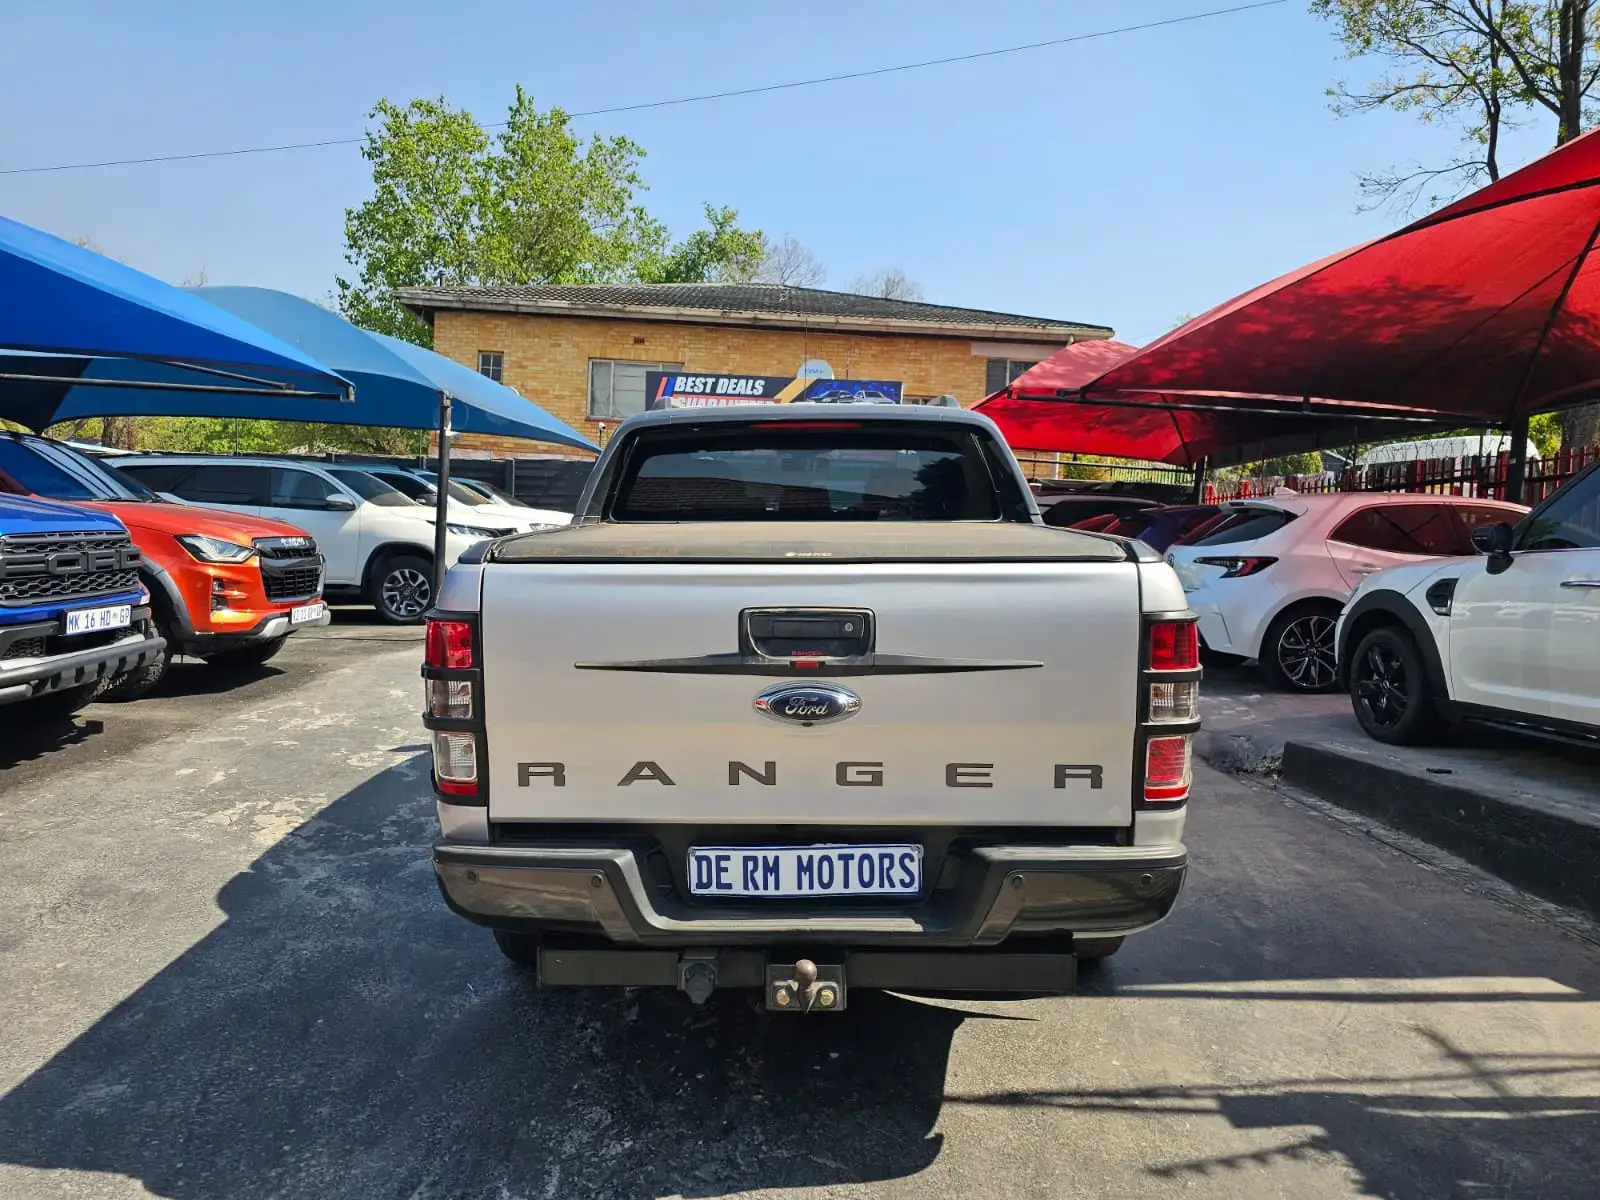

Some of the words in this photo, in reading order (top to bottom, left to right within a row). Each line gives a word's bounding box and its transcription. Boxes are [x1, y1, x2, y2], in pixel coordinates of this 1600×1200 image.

[674, 377, 714, 393] BEST
[716, 378, 765, 396] DEALS
[68, 613, 80, 631] MK
[85, 612, 95, 629] 16
[100, 609, 111, 625] HD
[120, 607, 130, 623] GP
[785, 697, 829, 715] Ford
[517, 761, 1103, 789] RANGER
[694, 854, 732, 890] DE
[742, 855, 780, 891] RM
[796, 852, 916, 891] MOTORS
